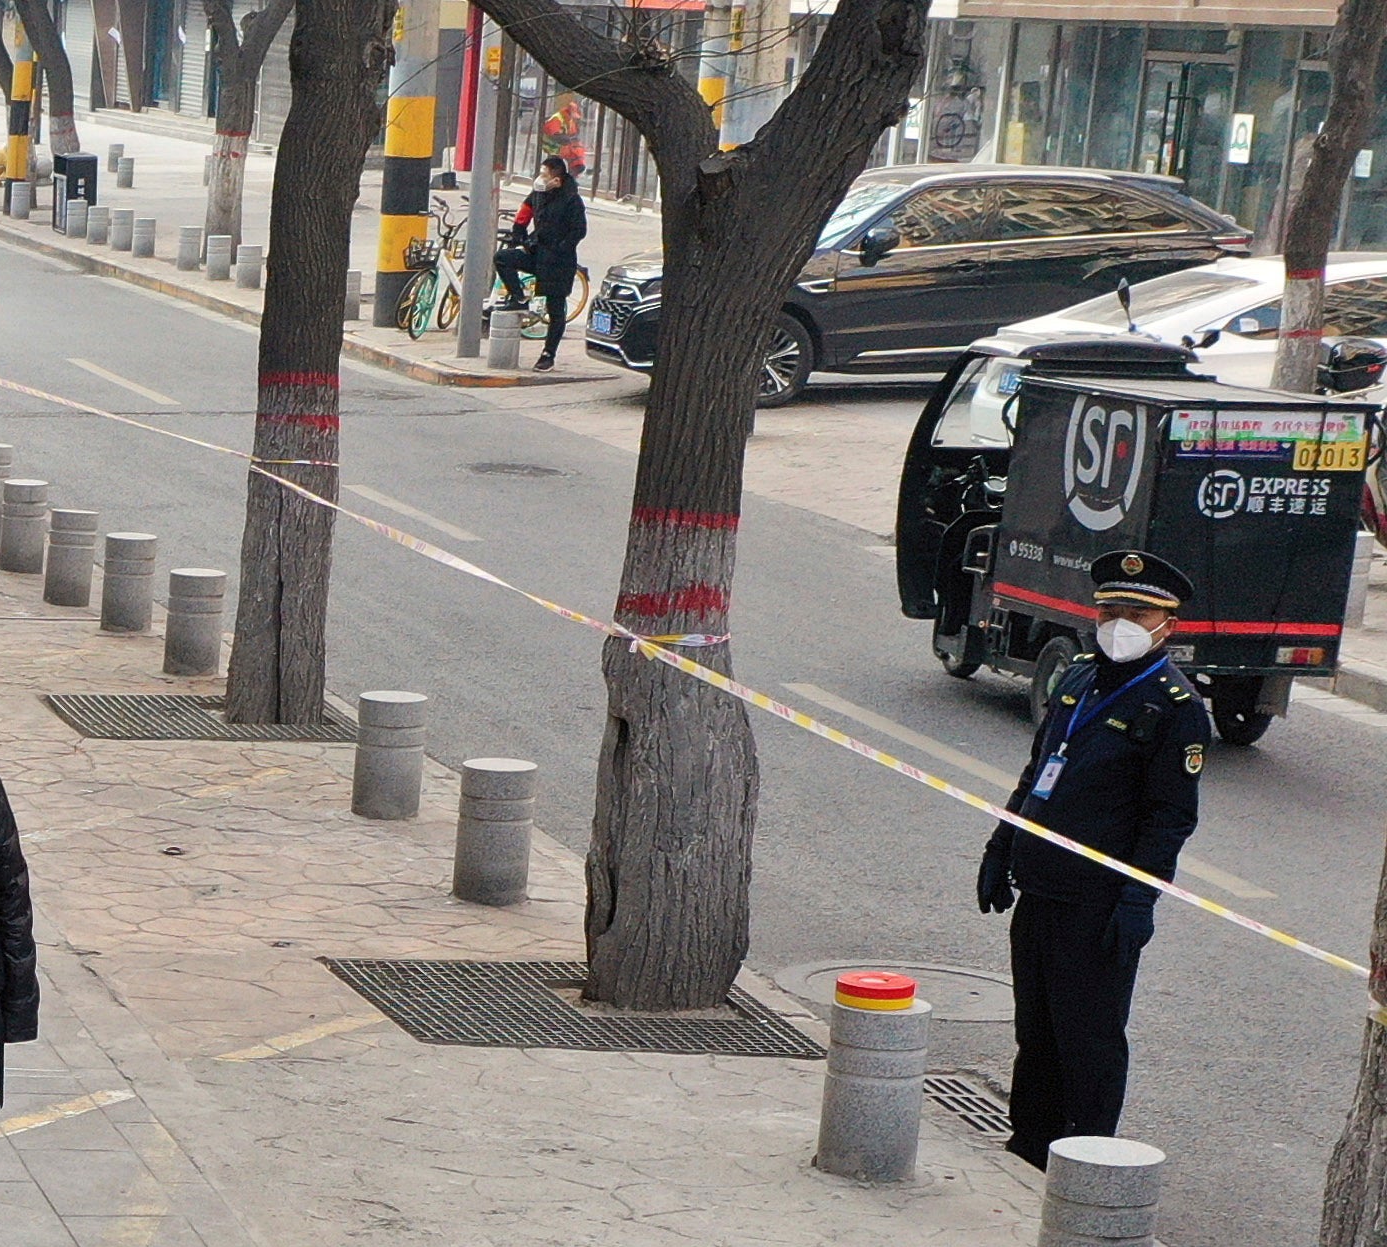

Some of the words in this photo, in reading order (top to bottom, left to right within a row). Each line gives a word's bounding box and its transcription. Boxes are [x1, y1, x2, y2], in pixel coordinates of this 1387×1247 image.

[1298, 447, 1359, 467] 02013
[1249, 476, 1331, 496] EXPRESS
[1246, 496, 1327, 515] 顺丰速运
[1018, 542, 1044, 562] 95338
